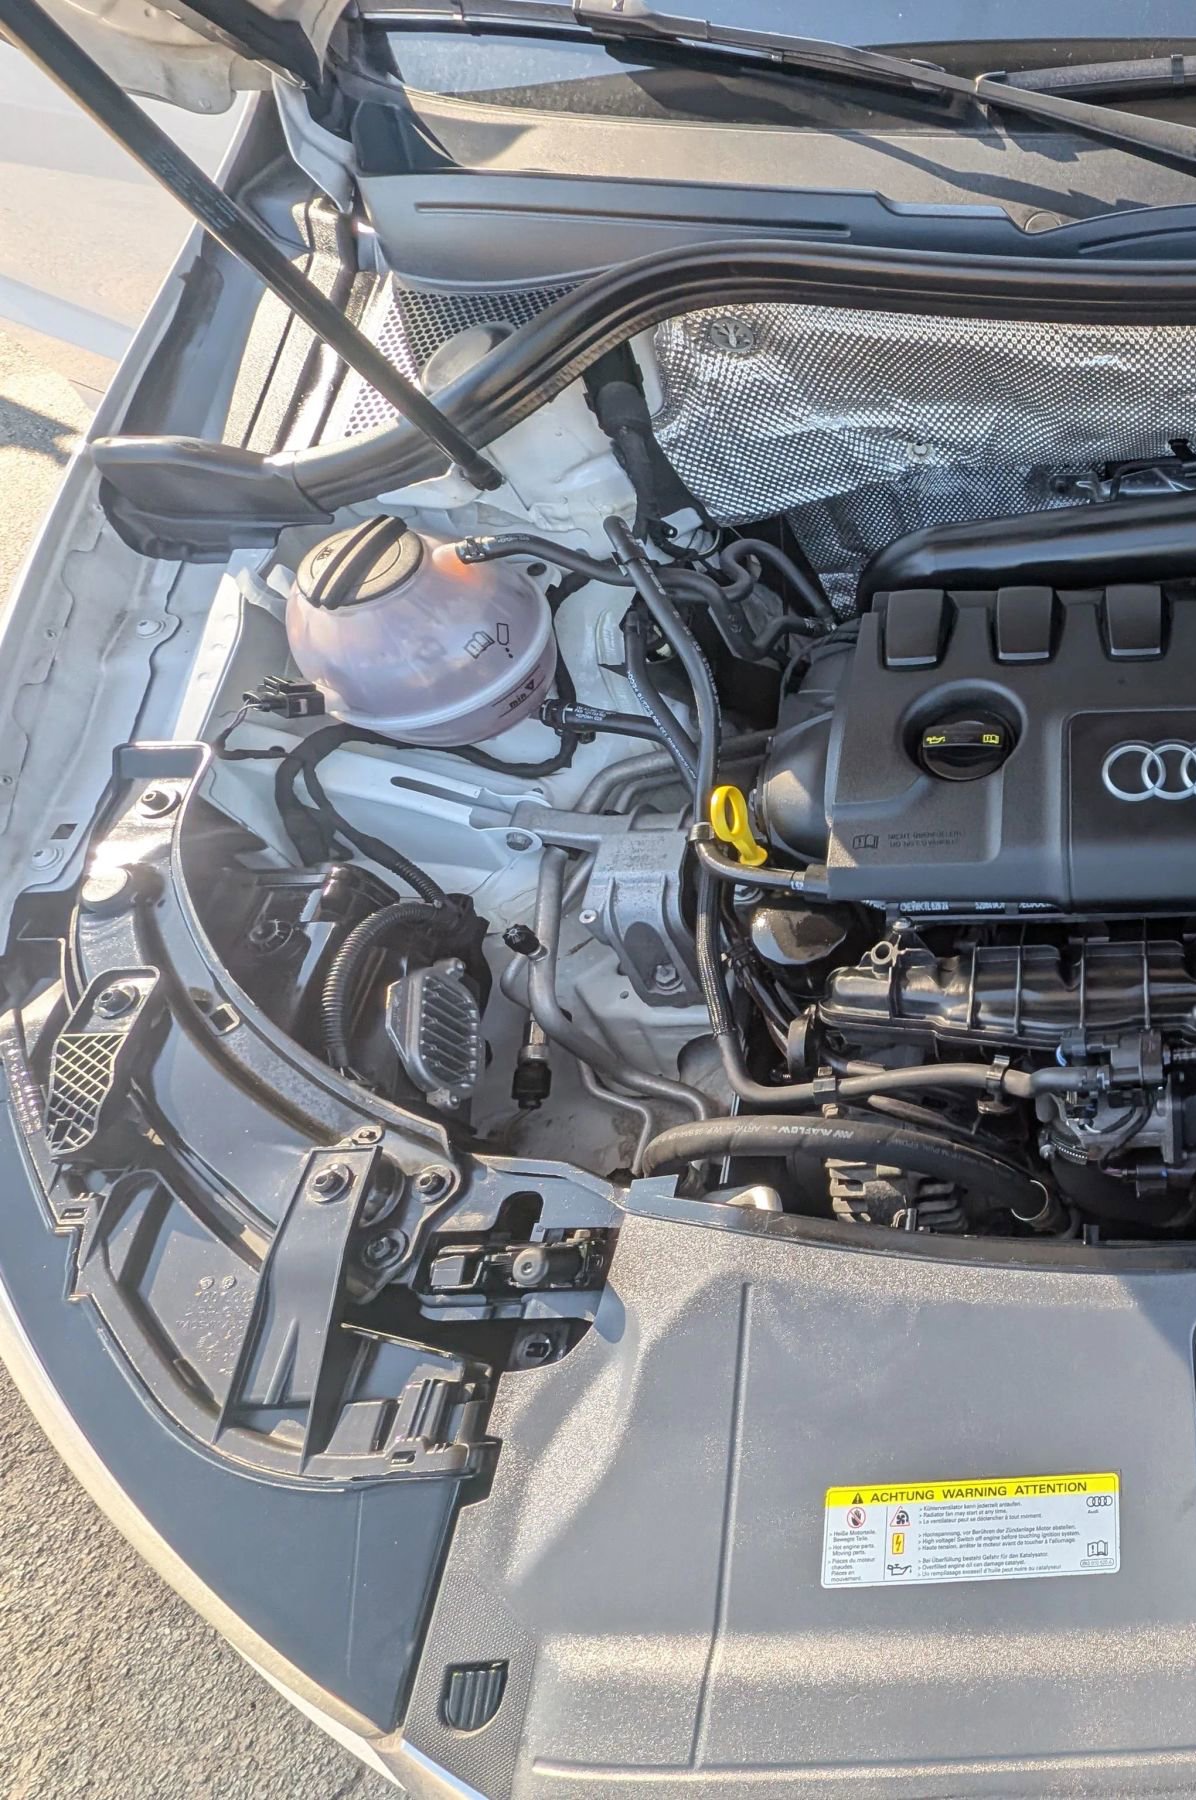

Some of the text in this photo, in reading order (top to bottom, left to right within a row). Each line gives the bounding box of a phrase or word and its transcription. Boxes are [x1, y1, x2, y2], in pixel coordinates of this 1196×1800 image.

[508, 692, 528, 708] min
[870, 1482, 1087, 1503] ACHTUNG WARNING ATTENTION
